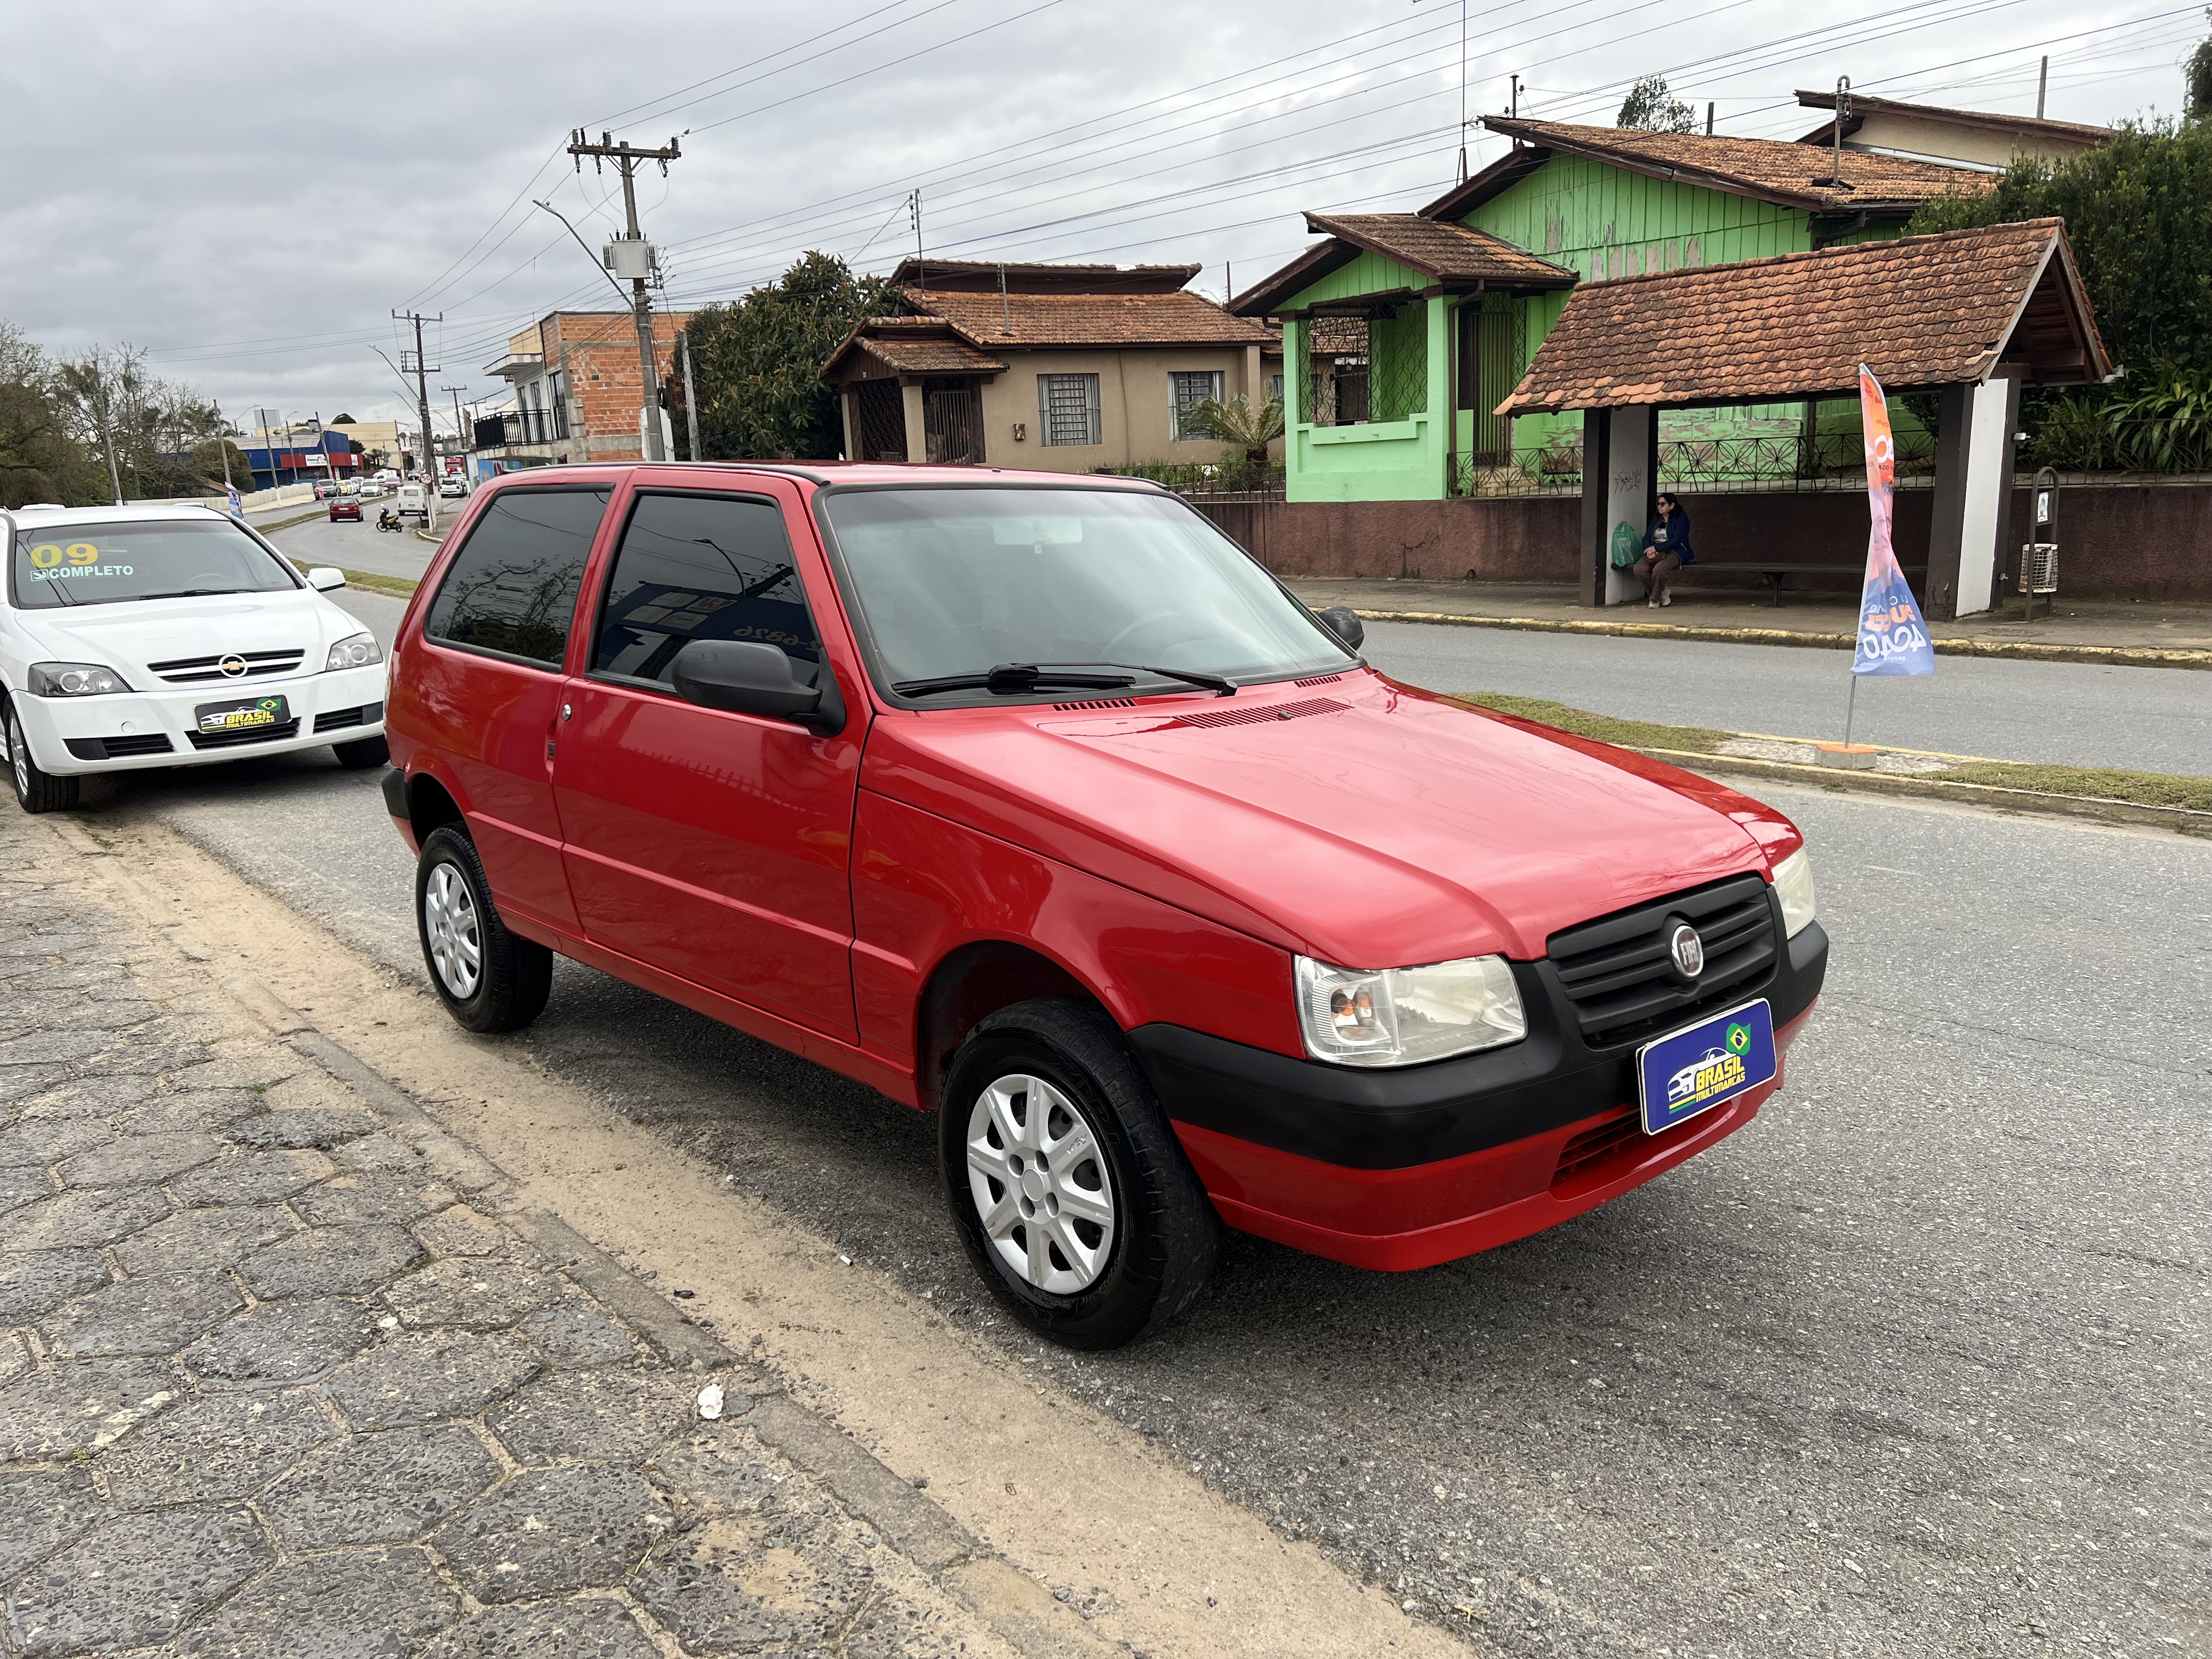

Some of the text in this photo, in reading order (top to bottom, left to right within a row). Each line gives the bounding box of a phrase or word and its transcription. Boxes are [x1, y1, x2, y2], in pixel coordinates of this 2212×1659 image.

[30, 543, 98, 568] 09
[49, 565, 133, 579] COMPLETO
[226, 710, 274, 724] BRASIL
[226, 718, 275, 729] MULTIMARCAS
[1679, 939, 1700, 966] FIAT
[1696, 1056, 1745, 1092] BRASIL
[1696, 1071, 1746, 1103] MULTIMARCAS
